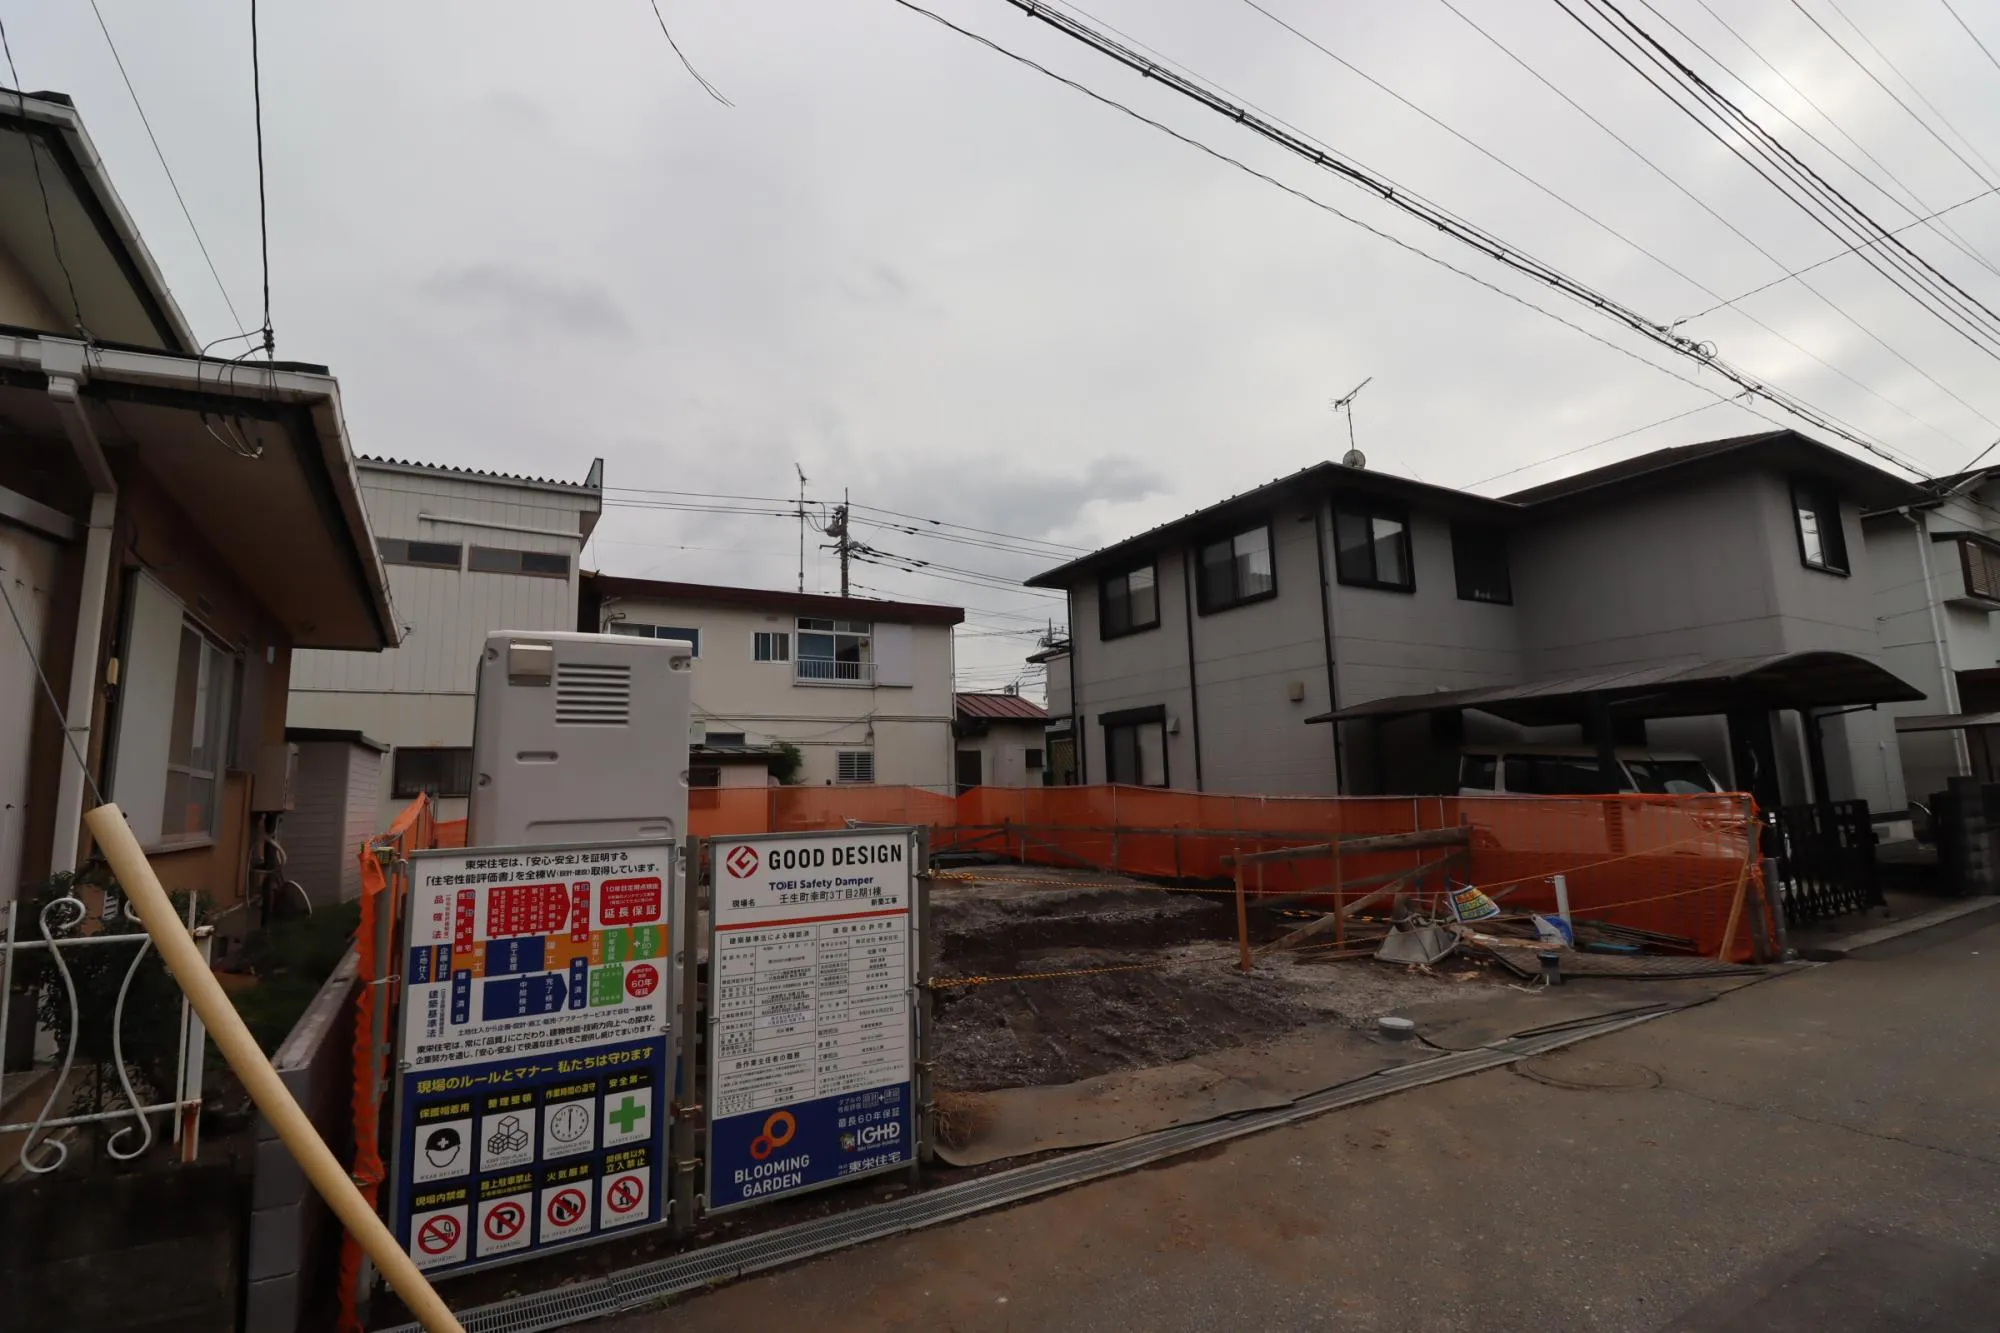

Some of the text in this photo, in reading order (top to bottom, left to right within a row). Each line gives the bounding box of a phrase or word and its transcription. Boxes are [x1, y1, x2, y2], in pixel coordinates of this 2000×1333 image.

[769, 844, 902, 870] GOOD DESIGN
[800, 879, 832, 890] Safety
[835, 876, 874, 887] Damper
[732, 899, 756, 908] 現場名
[780, 886, 882, 904] 壬生町幸町3丁目2期1棟
[432, 895, 443, 940] 品確法
[604, 904, 657, 918] 延長保証
[518, 981, 528, 1014] 中間検査
[635, 987, 649, 997] 保証
[427, 989, 439, 1037] 建築基準法
[416, 1047, 654, 1094] 現場のルールとマナー 私たちは守ります
[609, 1074, 649, 1089] 安全第一
[488, 1092, 532, 1109] 整理整頓
[420, 1103, 470, 1119] 保護帽着用
[838, 1106, 900, 1129] 最長60年保証
[857, 1122, 900, 1146] IGHD
[606, 1148, 646, 1163] 関係者以外
[848, 1151, 901, 1173] 東栄住宅
[547, 1165, 589, 1181] 火気厳禁
[606, 1158, 646, 1174] 立入禁止
[734, 1154, 810, 1184] BLOOMING
[481, 1172, 533, 1190] 路上駐車禁止
[742, 1171, 801, 1198] GARDEN
[416, 1188, 467, 1206] 現場内禁煙
